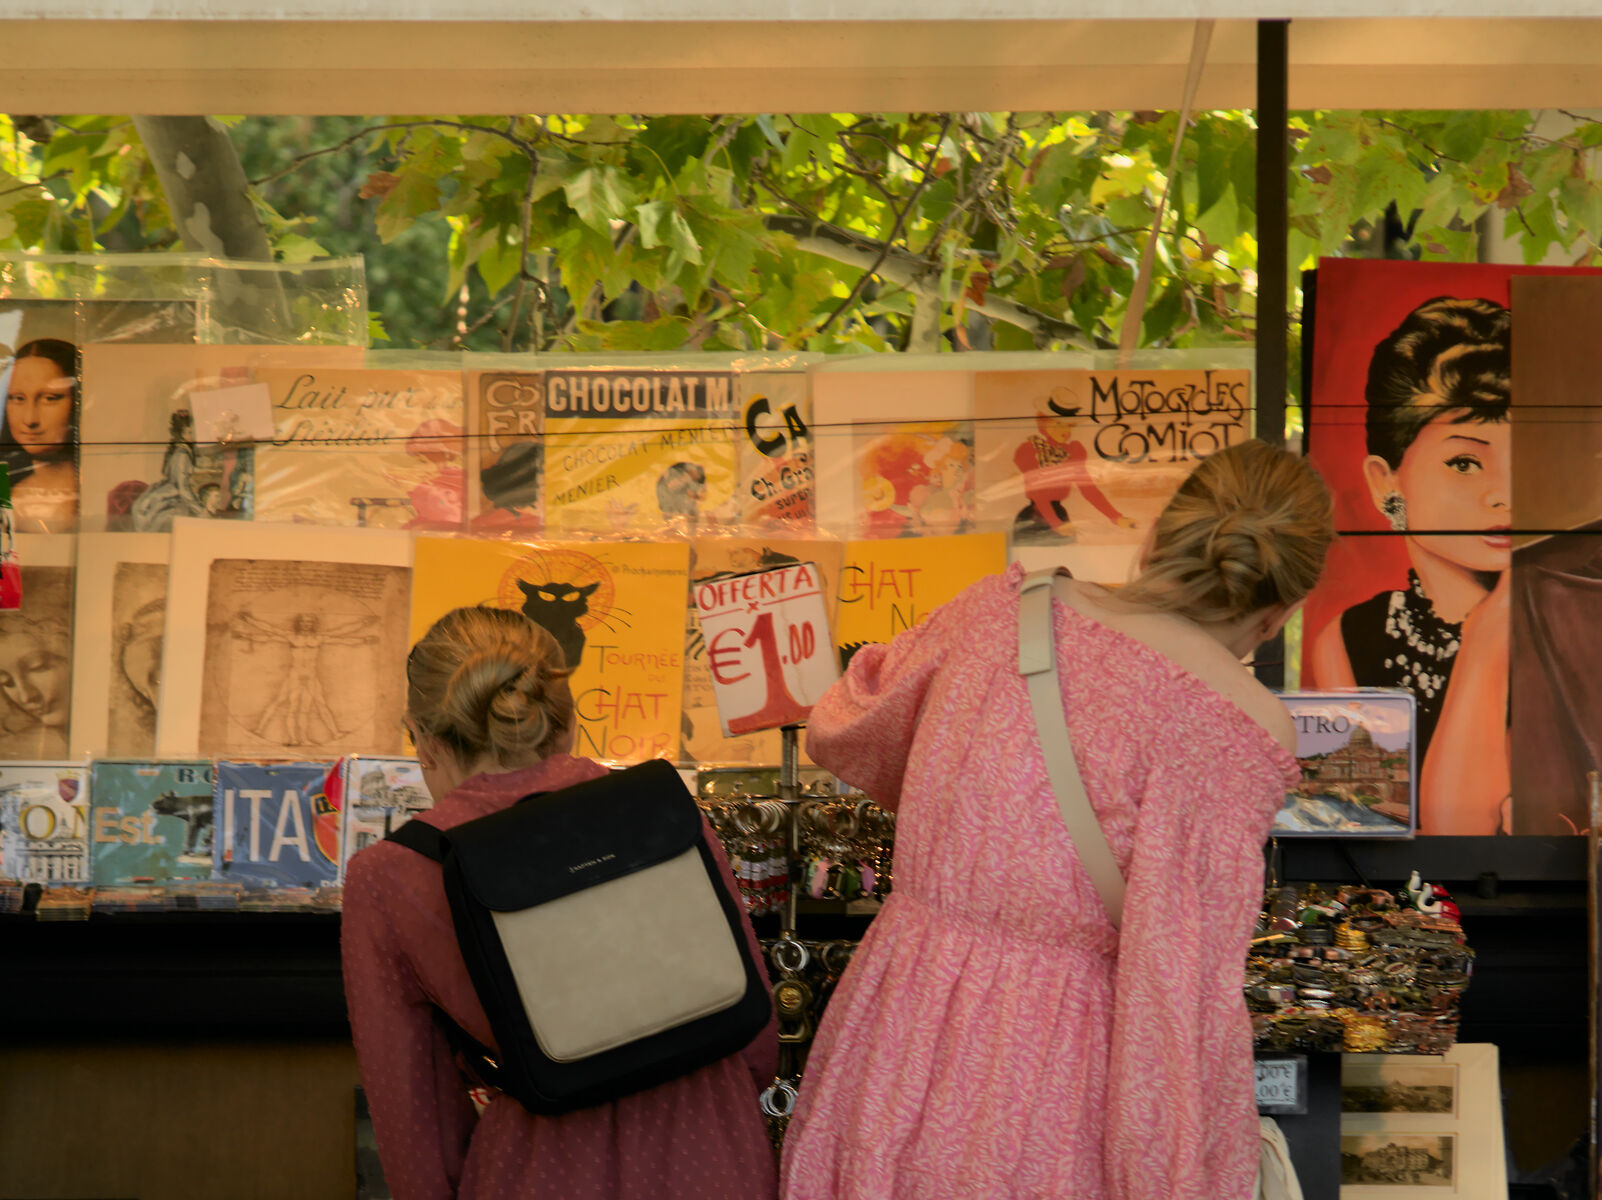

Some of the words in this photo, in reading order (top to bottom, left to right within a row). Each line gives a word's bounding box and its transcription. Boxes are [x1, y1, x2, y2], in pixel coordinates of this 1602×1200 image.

[273, 374, 347, 410] Lait
[549, 375, 698, 413] CHOCOLAT
[1094, 421, 1243, 464] COMIOT
[555, 473, 621, 504] MENIER
[698, 565, 814, 612] OFFERTA
[836, 560, 923, 611] CHAT
[575, 685, 669, 730] CHAT
[1291, 713, 1350, 734] TRO
